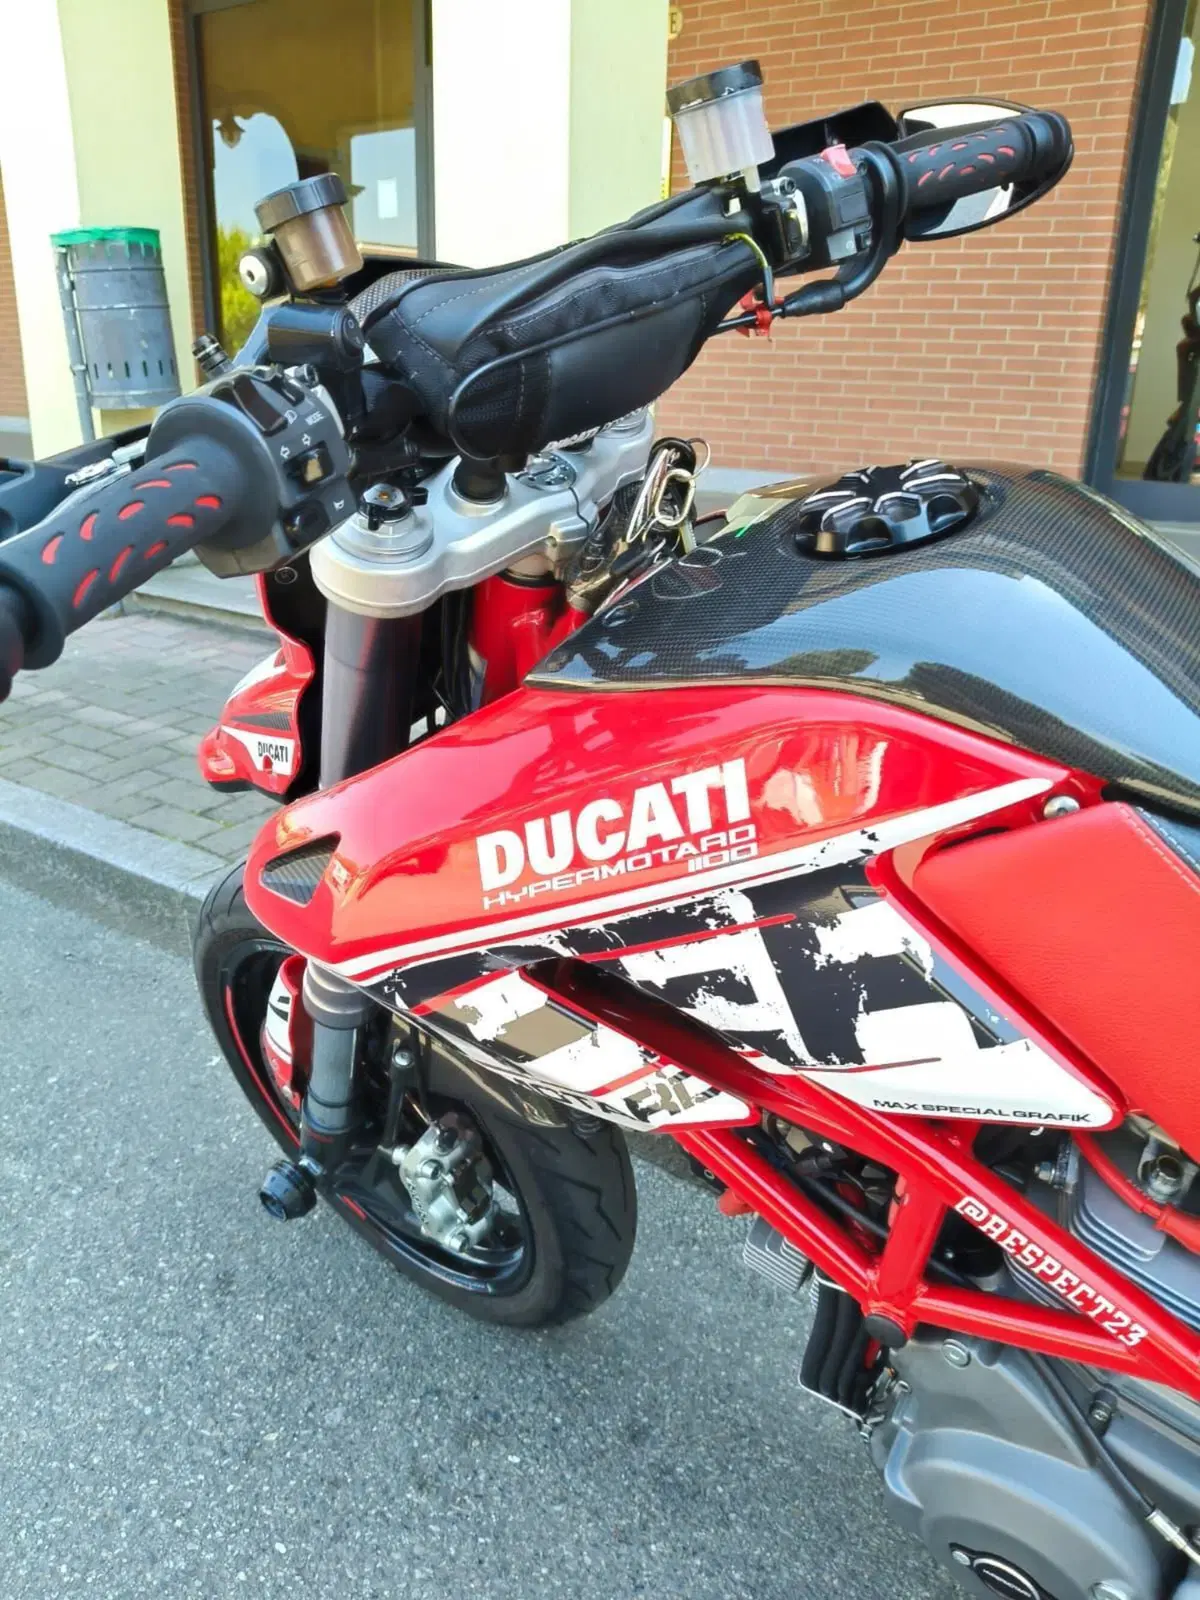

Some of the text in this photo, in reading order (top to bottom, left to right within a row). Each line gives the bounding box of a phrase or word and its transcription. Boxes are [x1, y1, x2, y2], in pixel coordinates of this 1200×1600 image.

[257, 741, 288, 763] DUCATI
[476, 757, 751, 891] DUCATI
[482, 824, 756, 910] HYPERMOTARD
[873, 1099, 1092, 1123] MAX SPECIAL GRAFIK
[954, 1195, 1149, 1346] @RESPECT23
